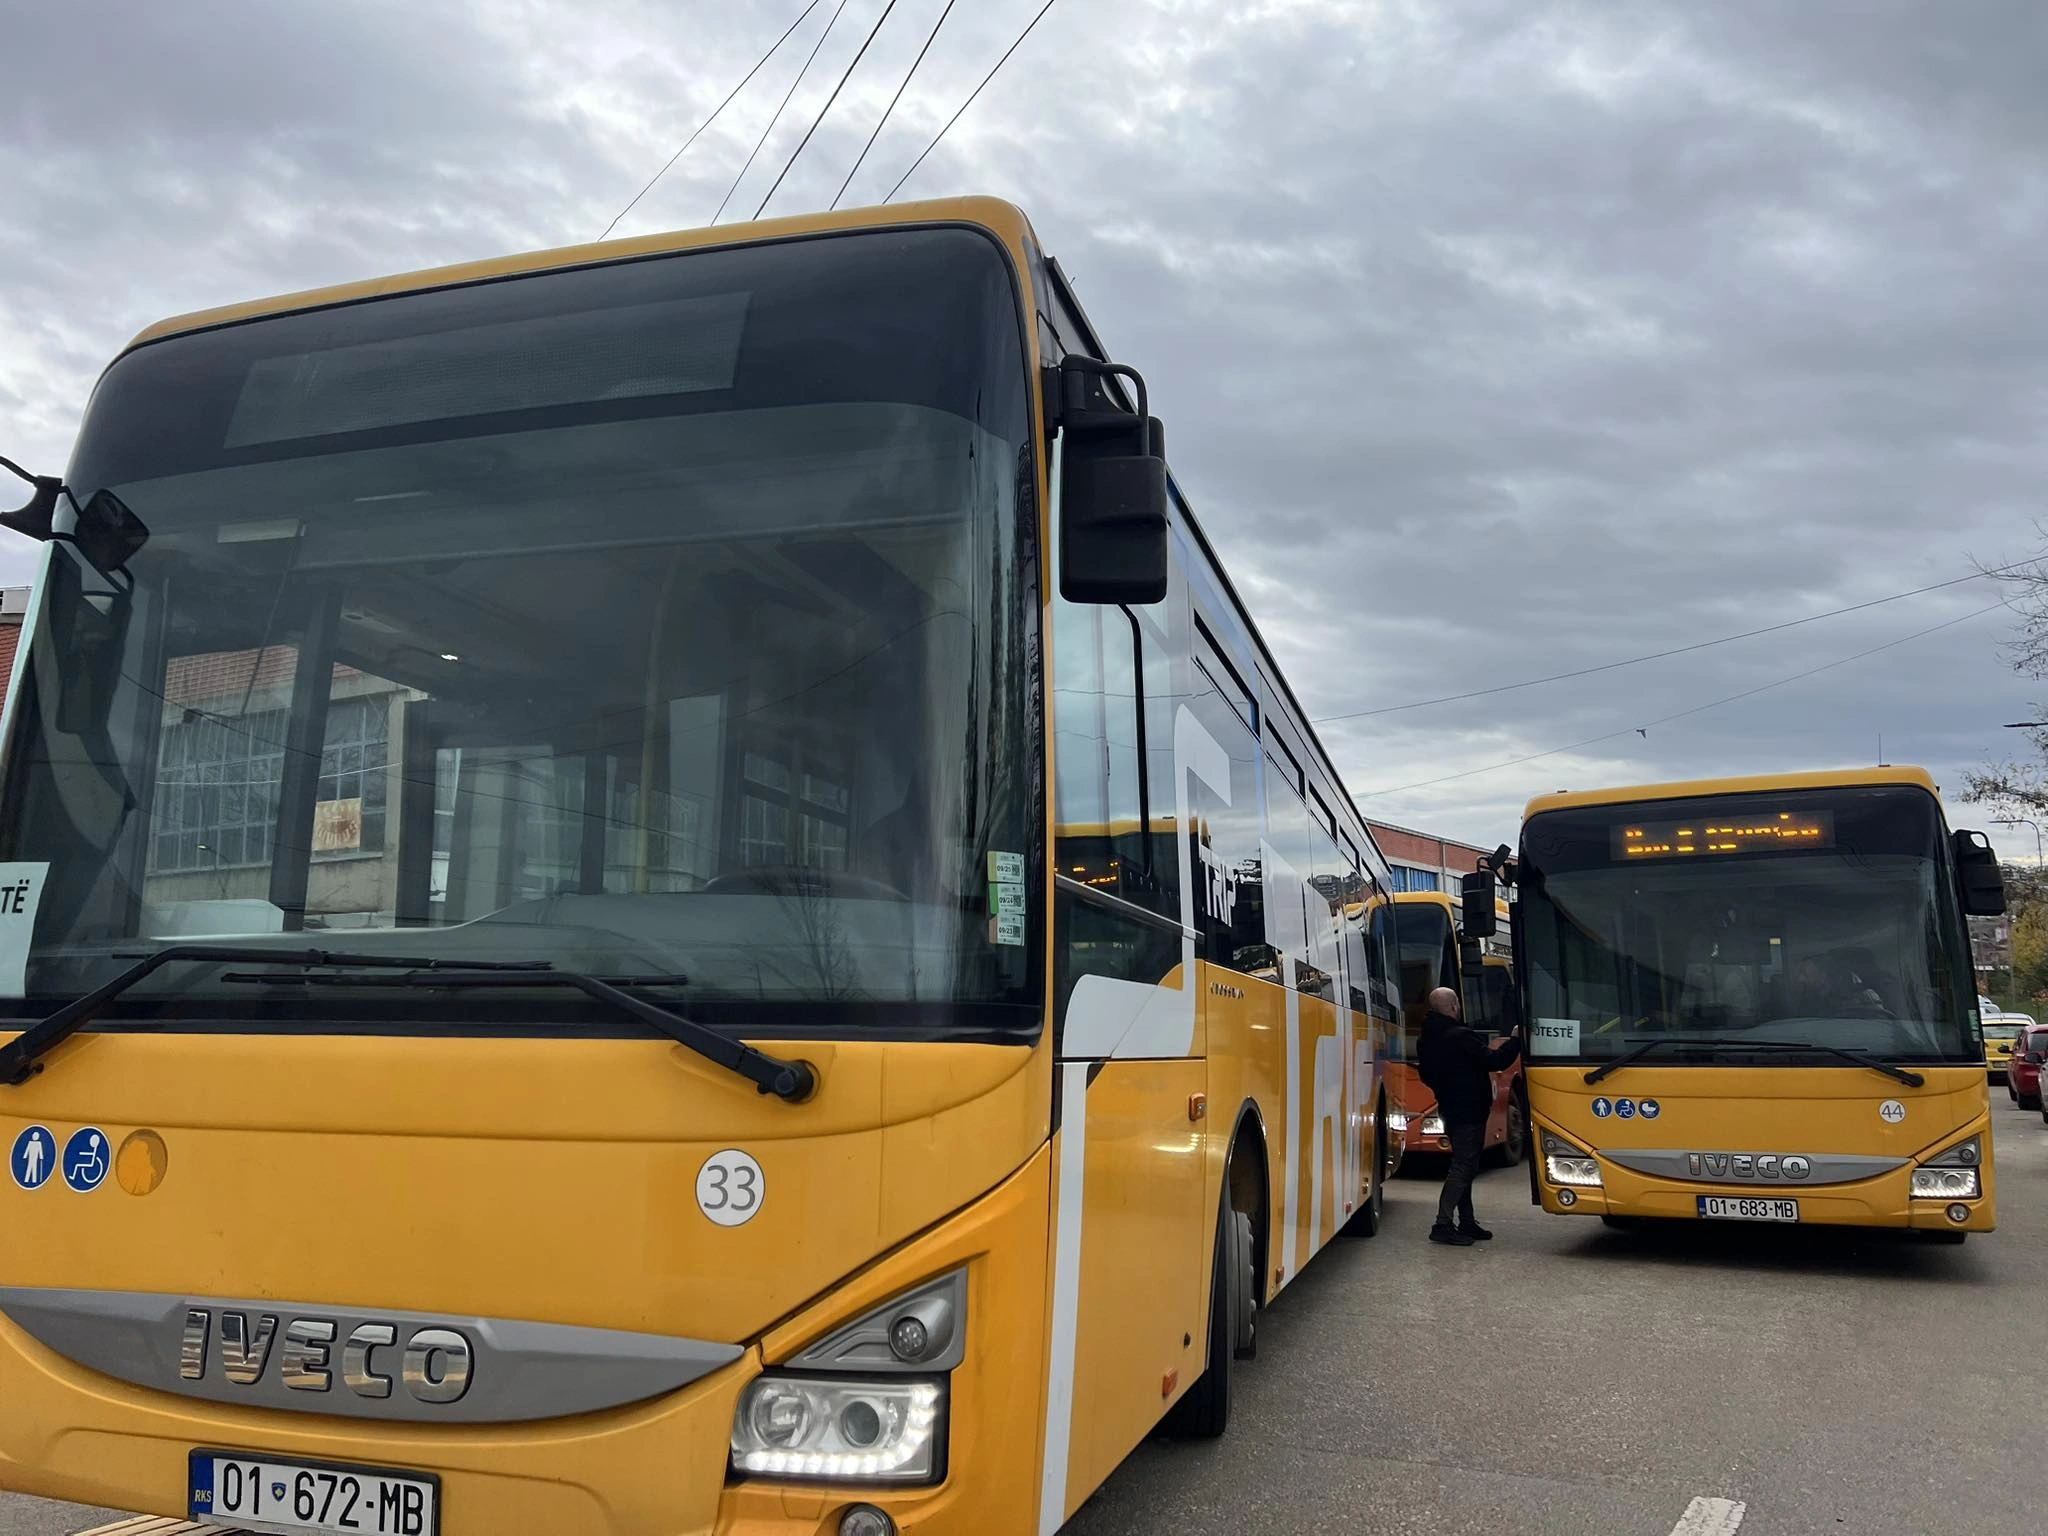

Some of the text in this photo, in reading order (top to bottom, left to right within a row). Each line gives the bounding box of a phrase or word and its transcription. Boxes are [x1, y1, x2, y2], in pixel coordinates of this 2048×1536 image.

[1882, 1104, 1904, 1119] 44
[1689, 1153, 1811, 1180] IVECO
[703, 1165, 756, 1211] 33
[1709, 1199, 1794, 1218] 01 683-MB
[181, 1309, 475, 1404] IVECO
[194, 1489, 213, 1503] RKS
[222, 1462, 424, 1536] 01 672-MB
